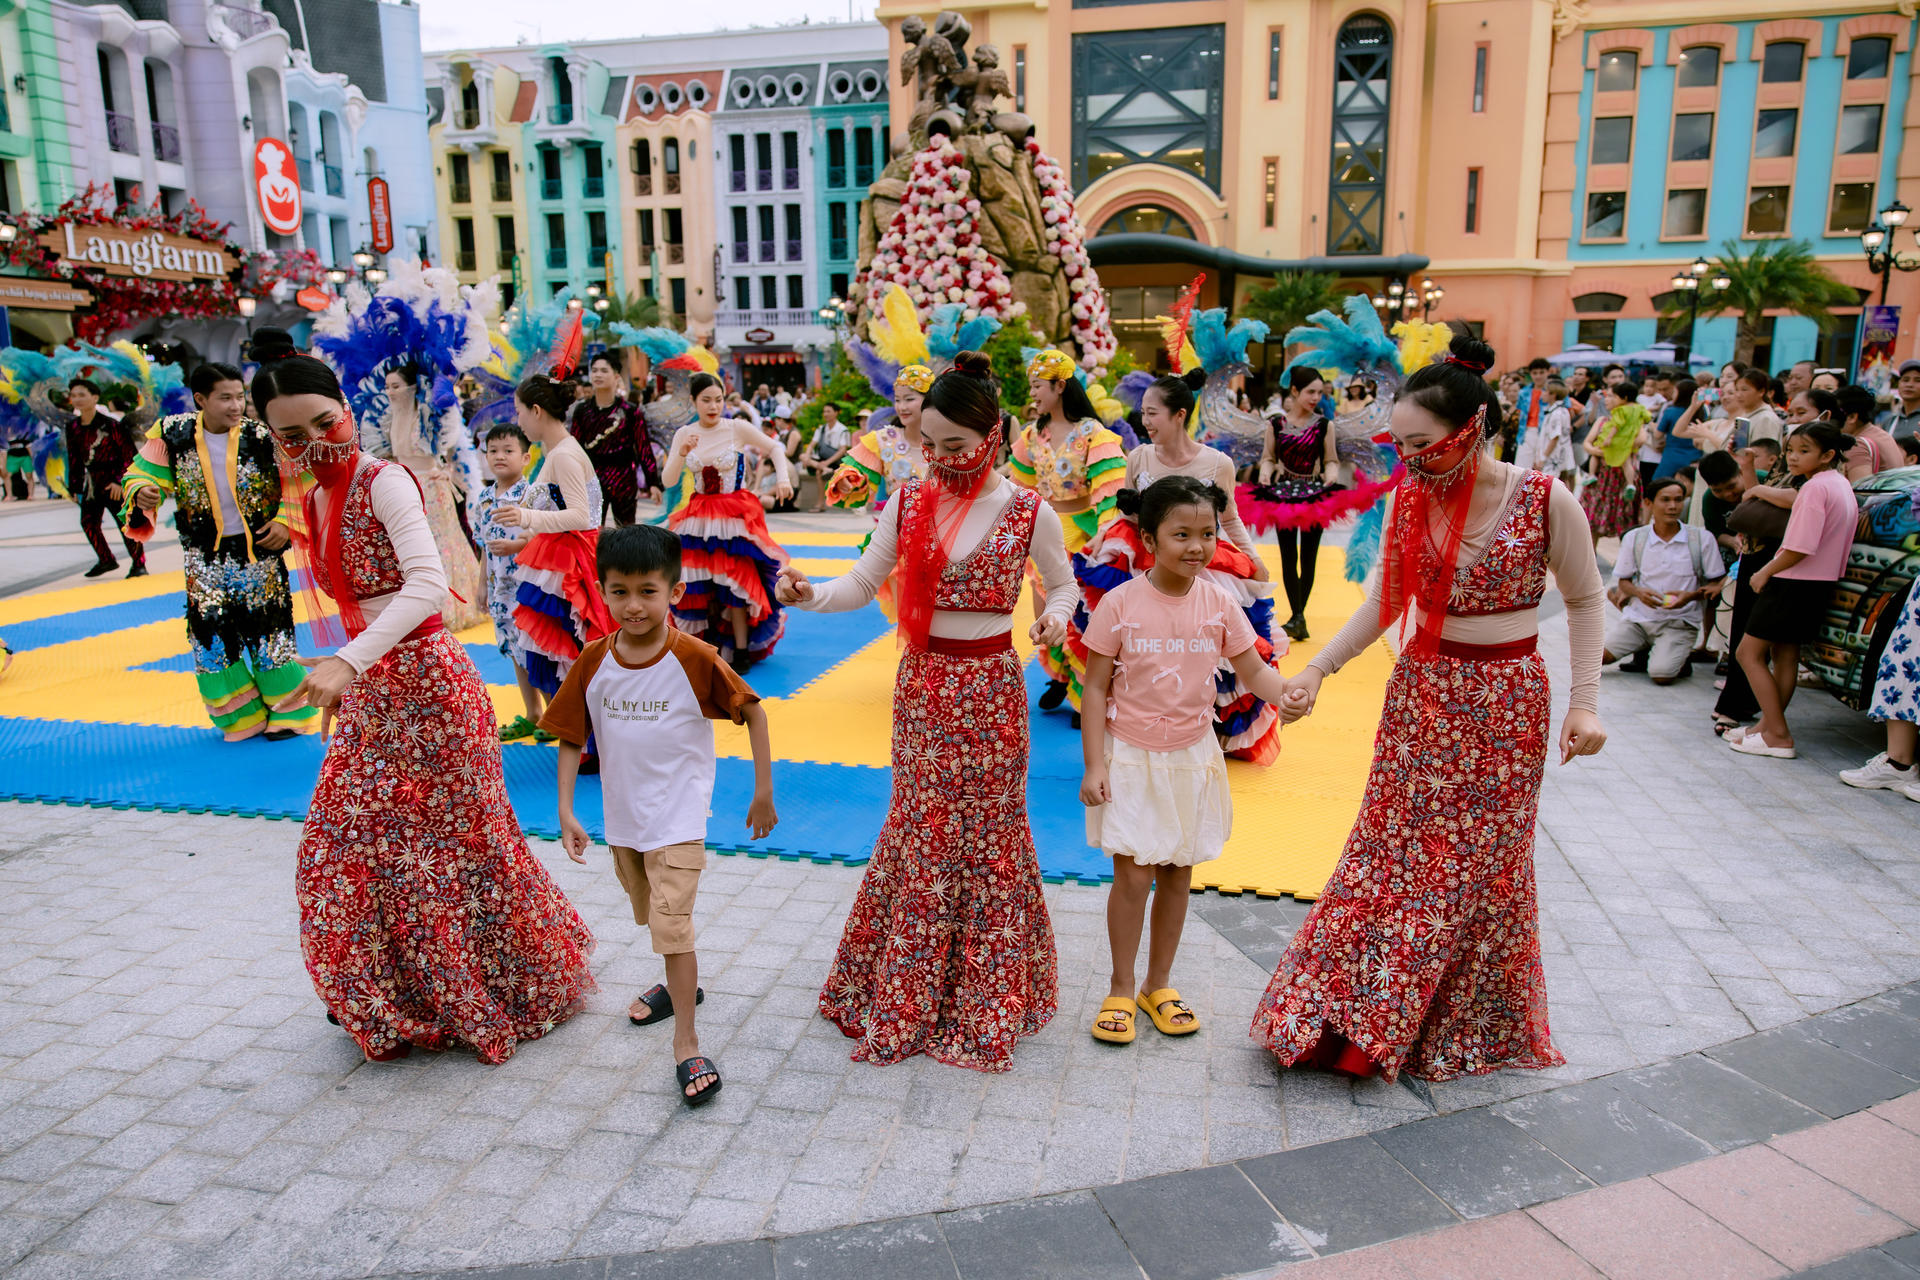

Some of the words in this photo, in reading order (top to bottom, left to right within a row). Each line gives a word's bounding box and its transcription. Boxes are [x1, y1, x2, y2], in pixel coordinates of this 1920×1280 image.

[372, 183, 388, 247] Langfarm
[64, 223, 225, 276] Langfarm
[1166, 638, 1185, 653] OR
[603, 697, 618, 711] ALL
[622, 700, 639, 712] MY
[642, 700, 669, 712] LIFE
